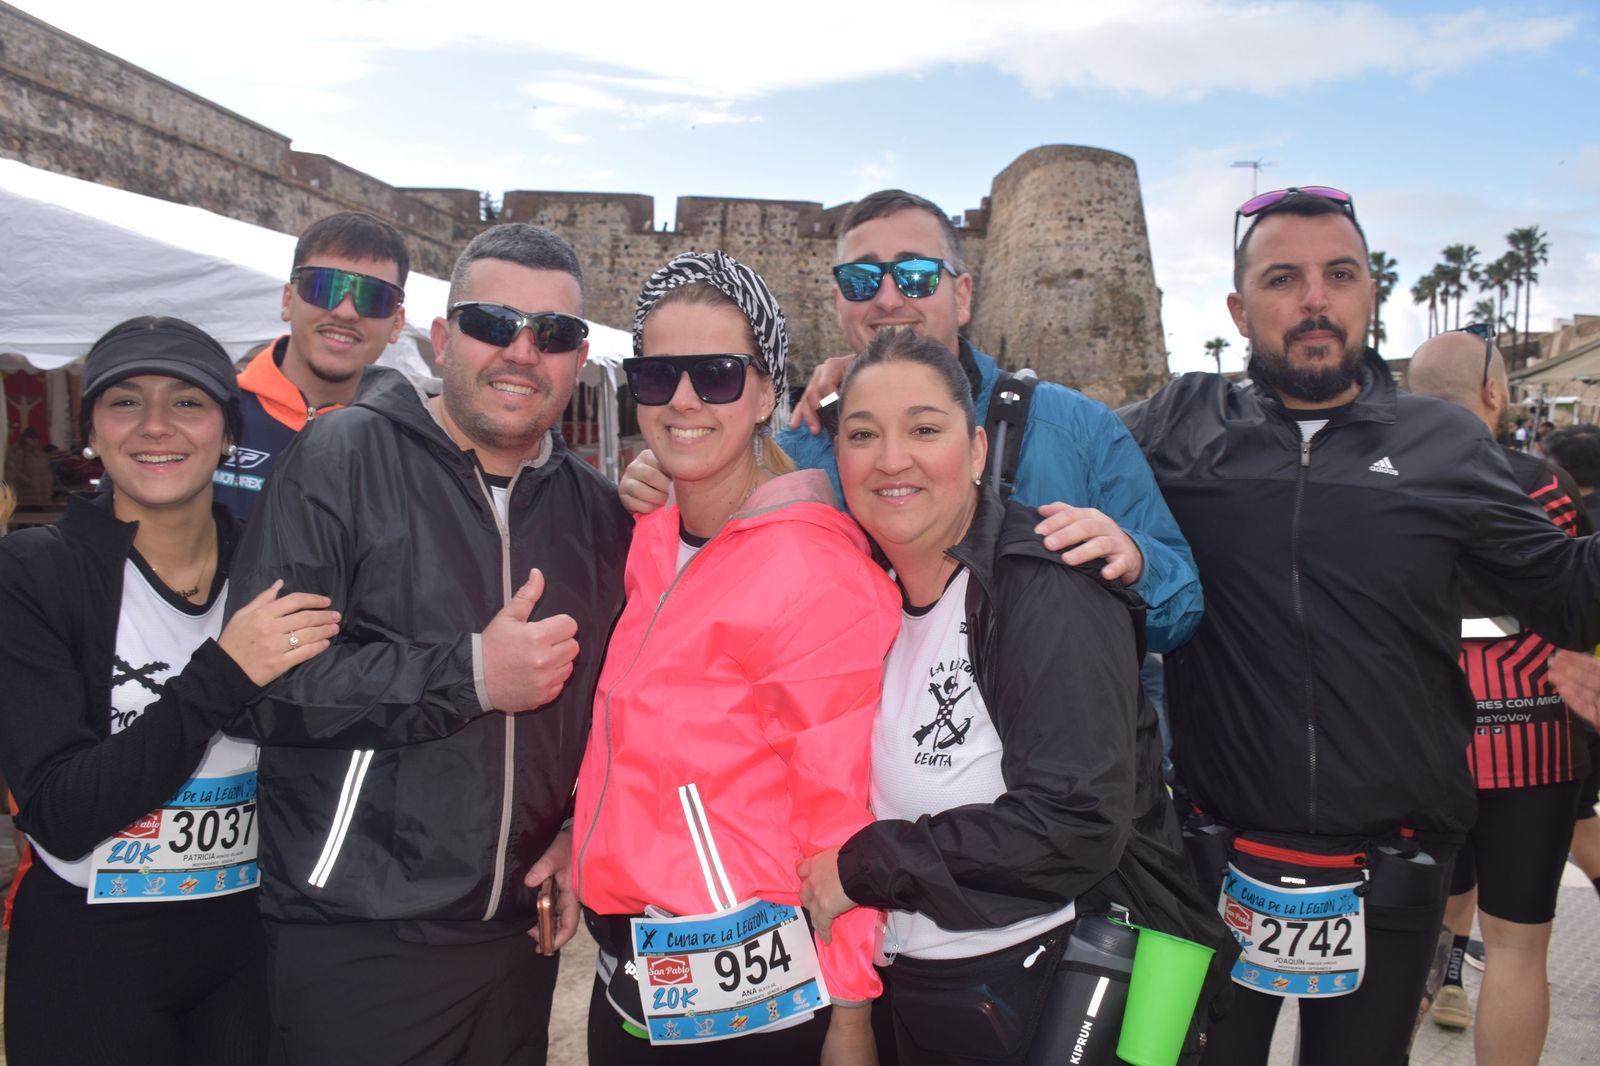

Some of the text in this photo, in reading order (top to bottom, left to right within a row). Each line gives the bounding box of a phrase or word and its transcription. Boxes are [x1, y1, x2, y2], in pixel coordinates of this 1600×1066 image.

[930, 661, 944, 678] LA
[1476, 700, 1503, 710] RES
[1506, 698, 1534, 708] CON
[914, 752, 951, 767] CEUTA
[169, 804, 256, 853] 3037
[107, 840, 161, 864] 20K
[183, 853, 216, 861] PATRICIA
[1300, 898, 1335, 915] LEGION
[642, 929, 656, 950] X
[667, 932, 698, 948] Cuna
[737, 909, 768, 938] LEGION
[1258, 918, 1352, 957] 2742
[649, 966, 664, 976] San
[666, 965, 690, 975] Pablo
[714, 930, 791, 992] 954
[652, 986, 699, 1010] 20K
[741, 987, 757, 997] ANA
[1069, 1020, 1093, 1065] KIPRUN
